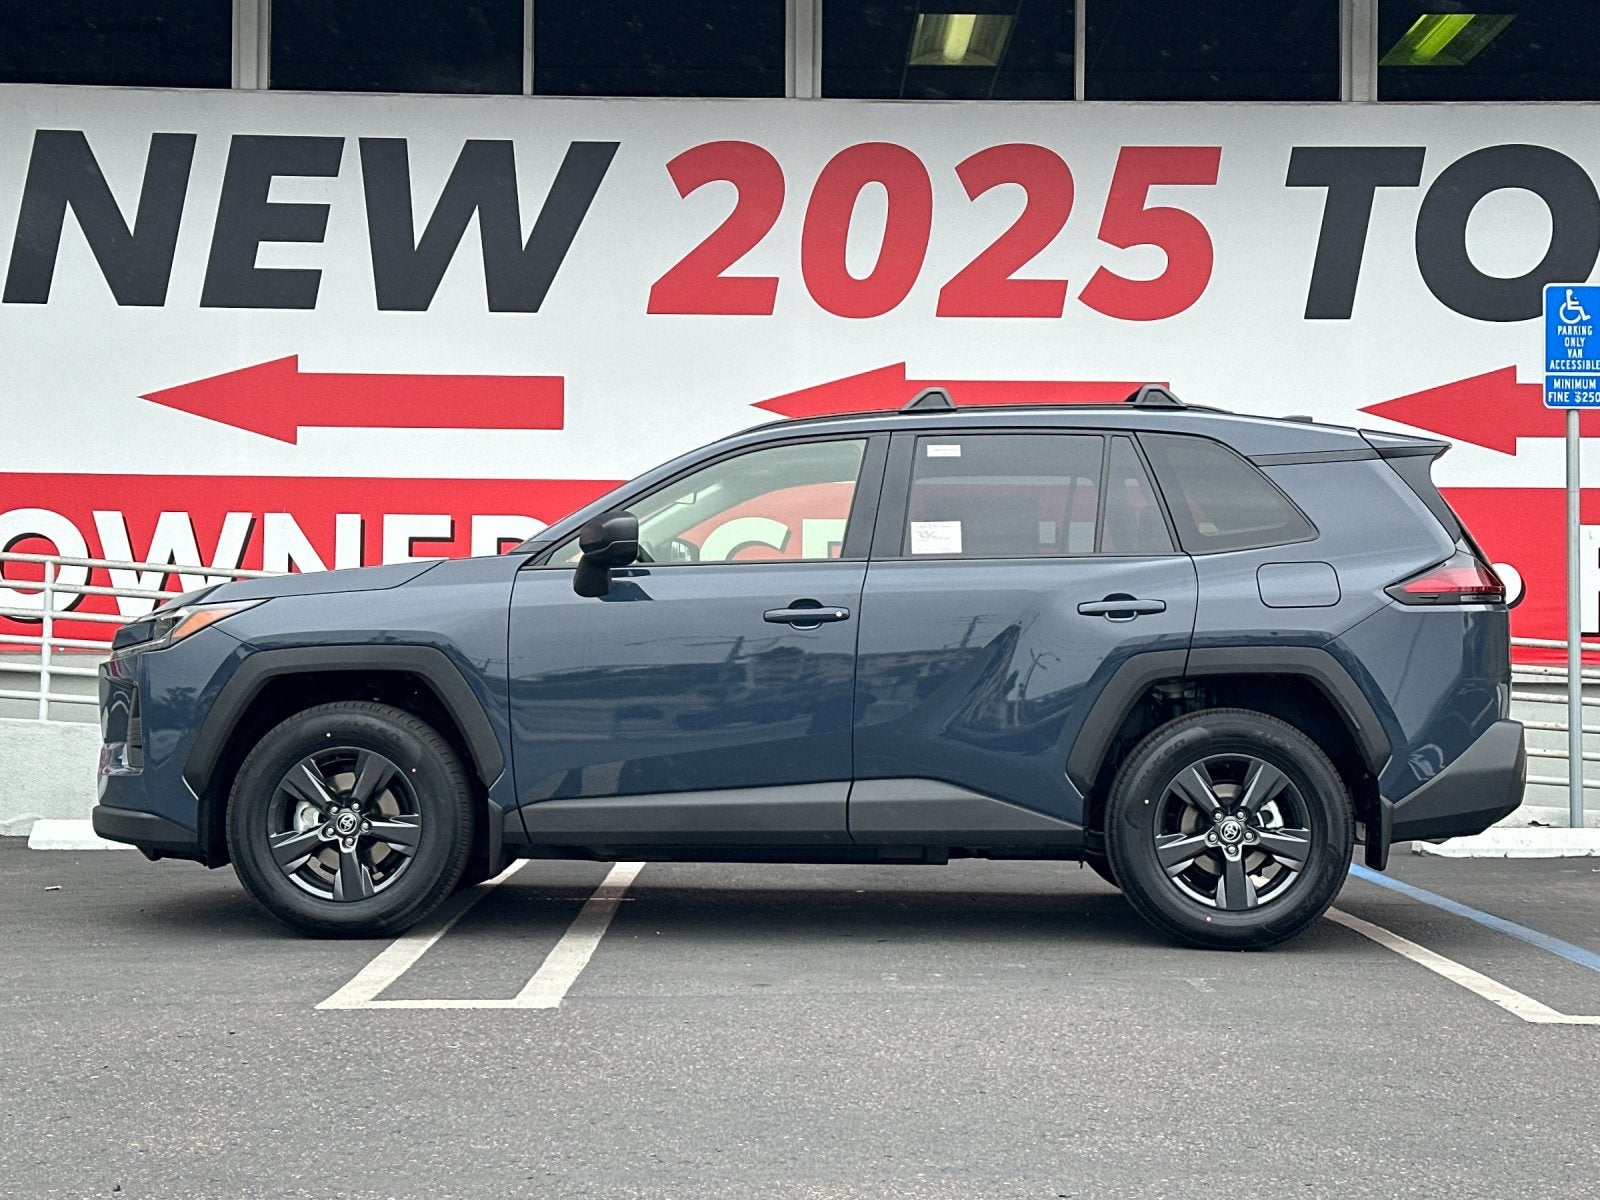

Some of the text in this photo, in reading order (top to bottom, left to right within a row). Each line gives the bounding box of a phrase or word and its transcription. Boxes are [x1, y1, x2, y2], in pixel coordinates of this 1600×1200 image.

[2, 129, 621, 313] NEW
[646, 140, 1223, 321] 2025
[1557, 325, 1593, 336] PARKING
[1564, 337, 1586, 347] ONLY
[1567, 348, 1583, 359] VAN
[1549, 360, 1600, 370] ACCESSIBLE
[1553, 378, 1597, 390] MINIMUM
[1548, 391, 1600, 404] FINE $250
